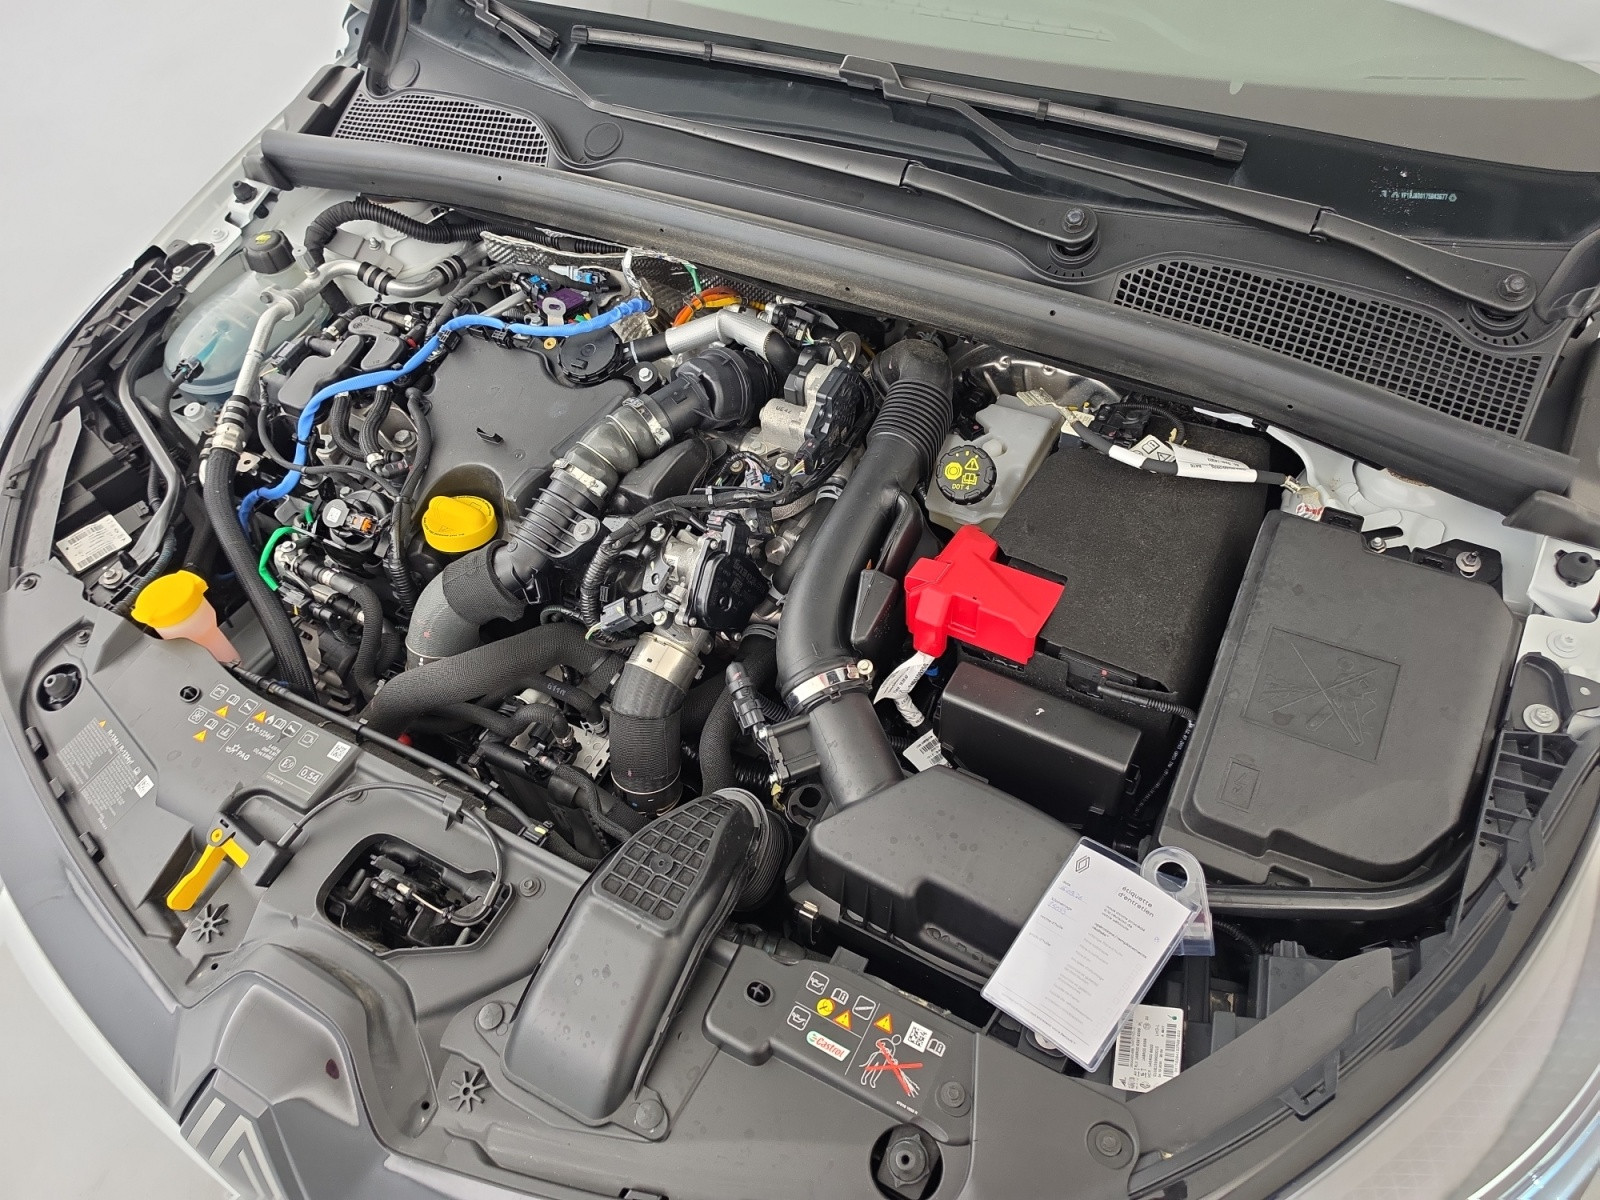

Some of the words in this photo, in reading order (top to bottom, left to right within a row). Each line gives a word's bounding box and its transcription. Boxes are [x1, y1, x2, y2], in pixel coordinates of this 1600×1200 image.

[300, 768, 319, 782] 0,54
[1118, 892, 1154, 917] d'entretien
[1122, 886, 1153, 908] étiquette
[816, 1038, 845, 1058] Castrol
